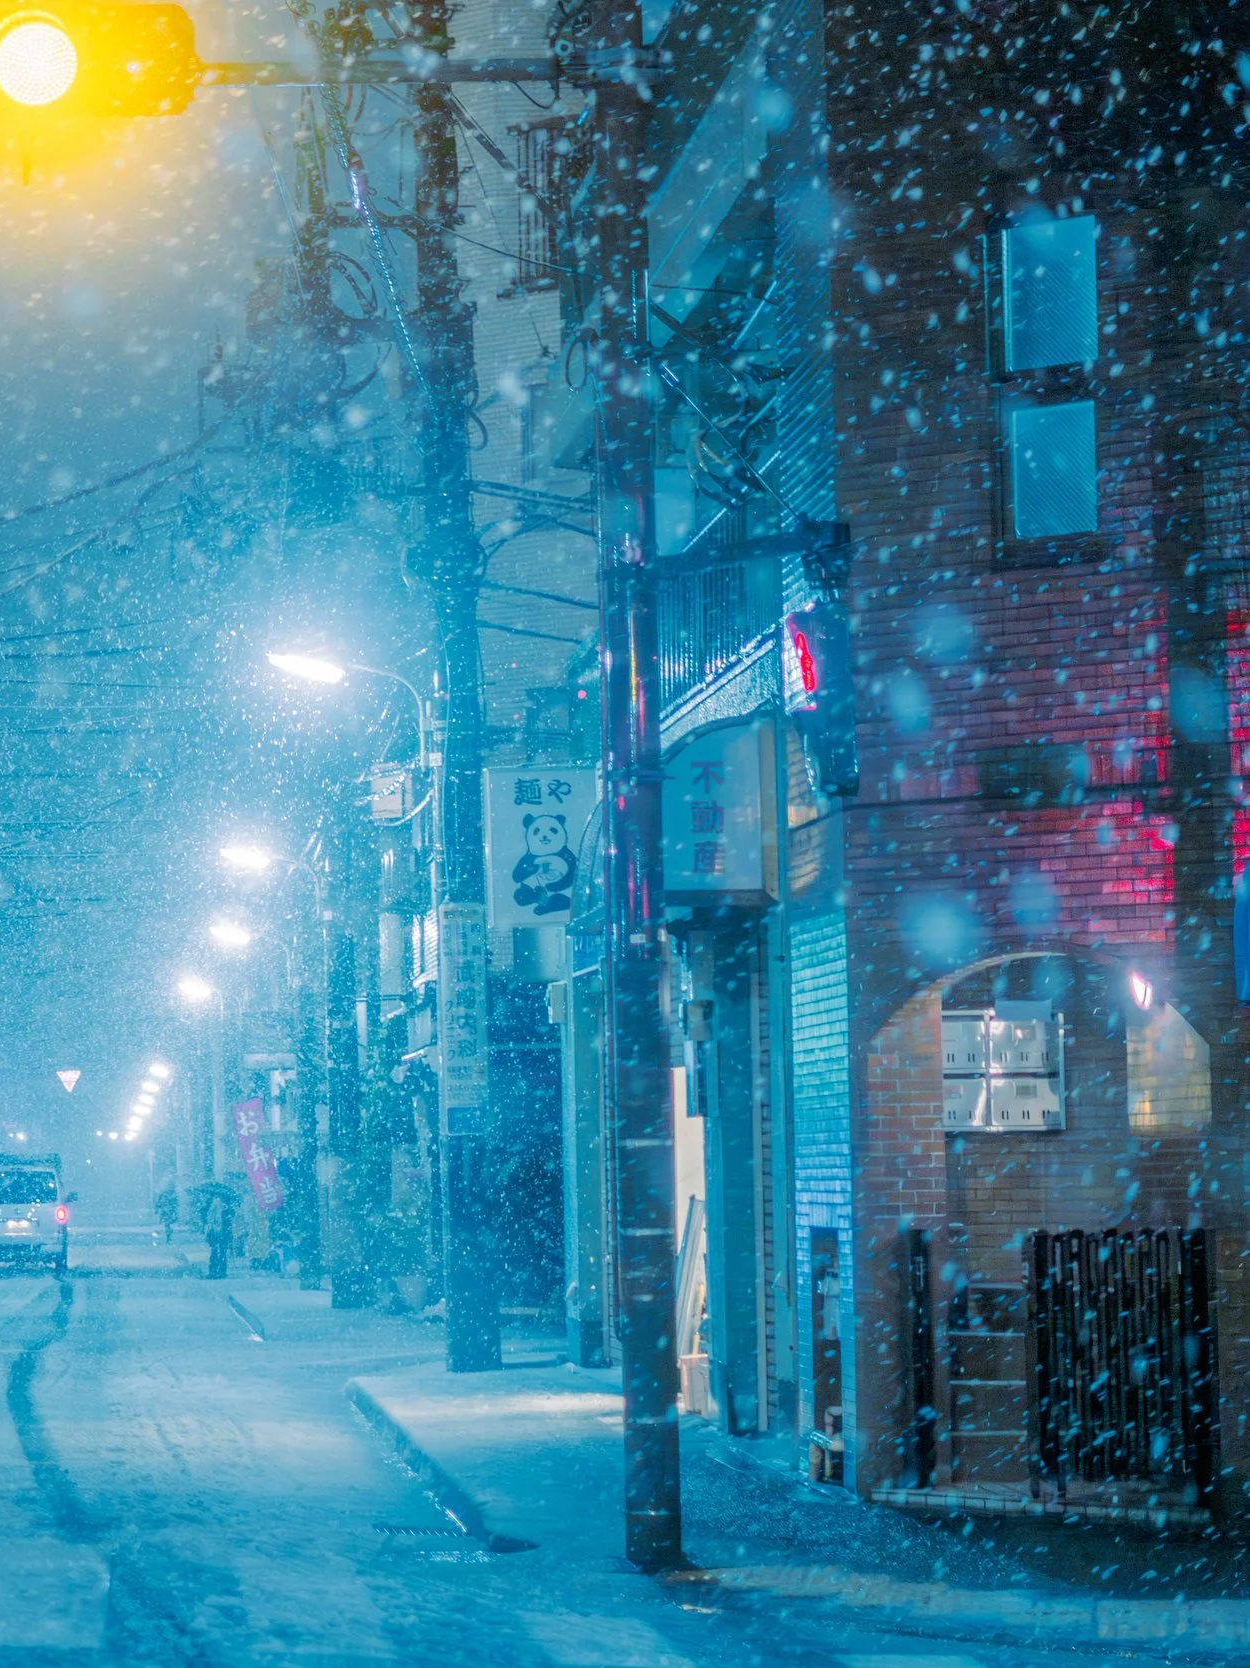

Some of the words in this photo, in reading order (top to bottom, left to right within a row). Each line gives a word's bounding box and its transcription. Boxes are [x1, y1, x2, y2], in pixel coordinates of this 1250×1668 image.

[513, 778, 572, 806] 麺や
[237, 1111, 278, 1204] お弁当
